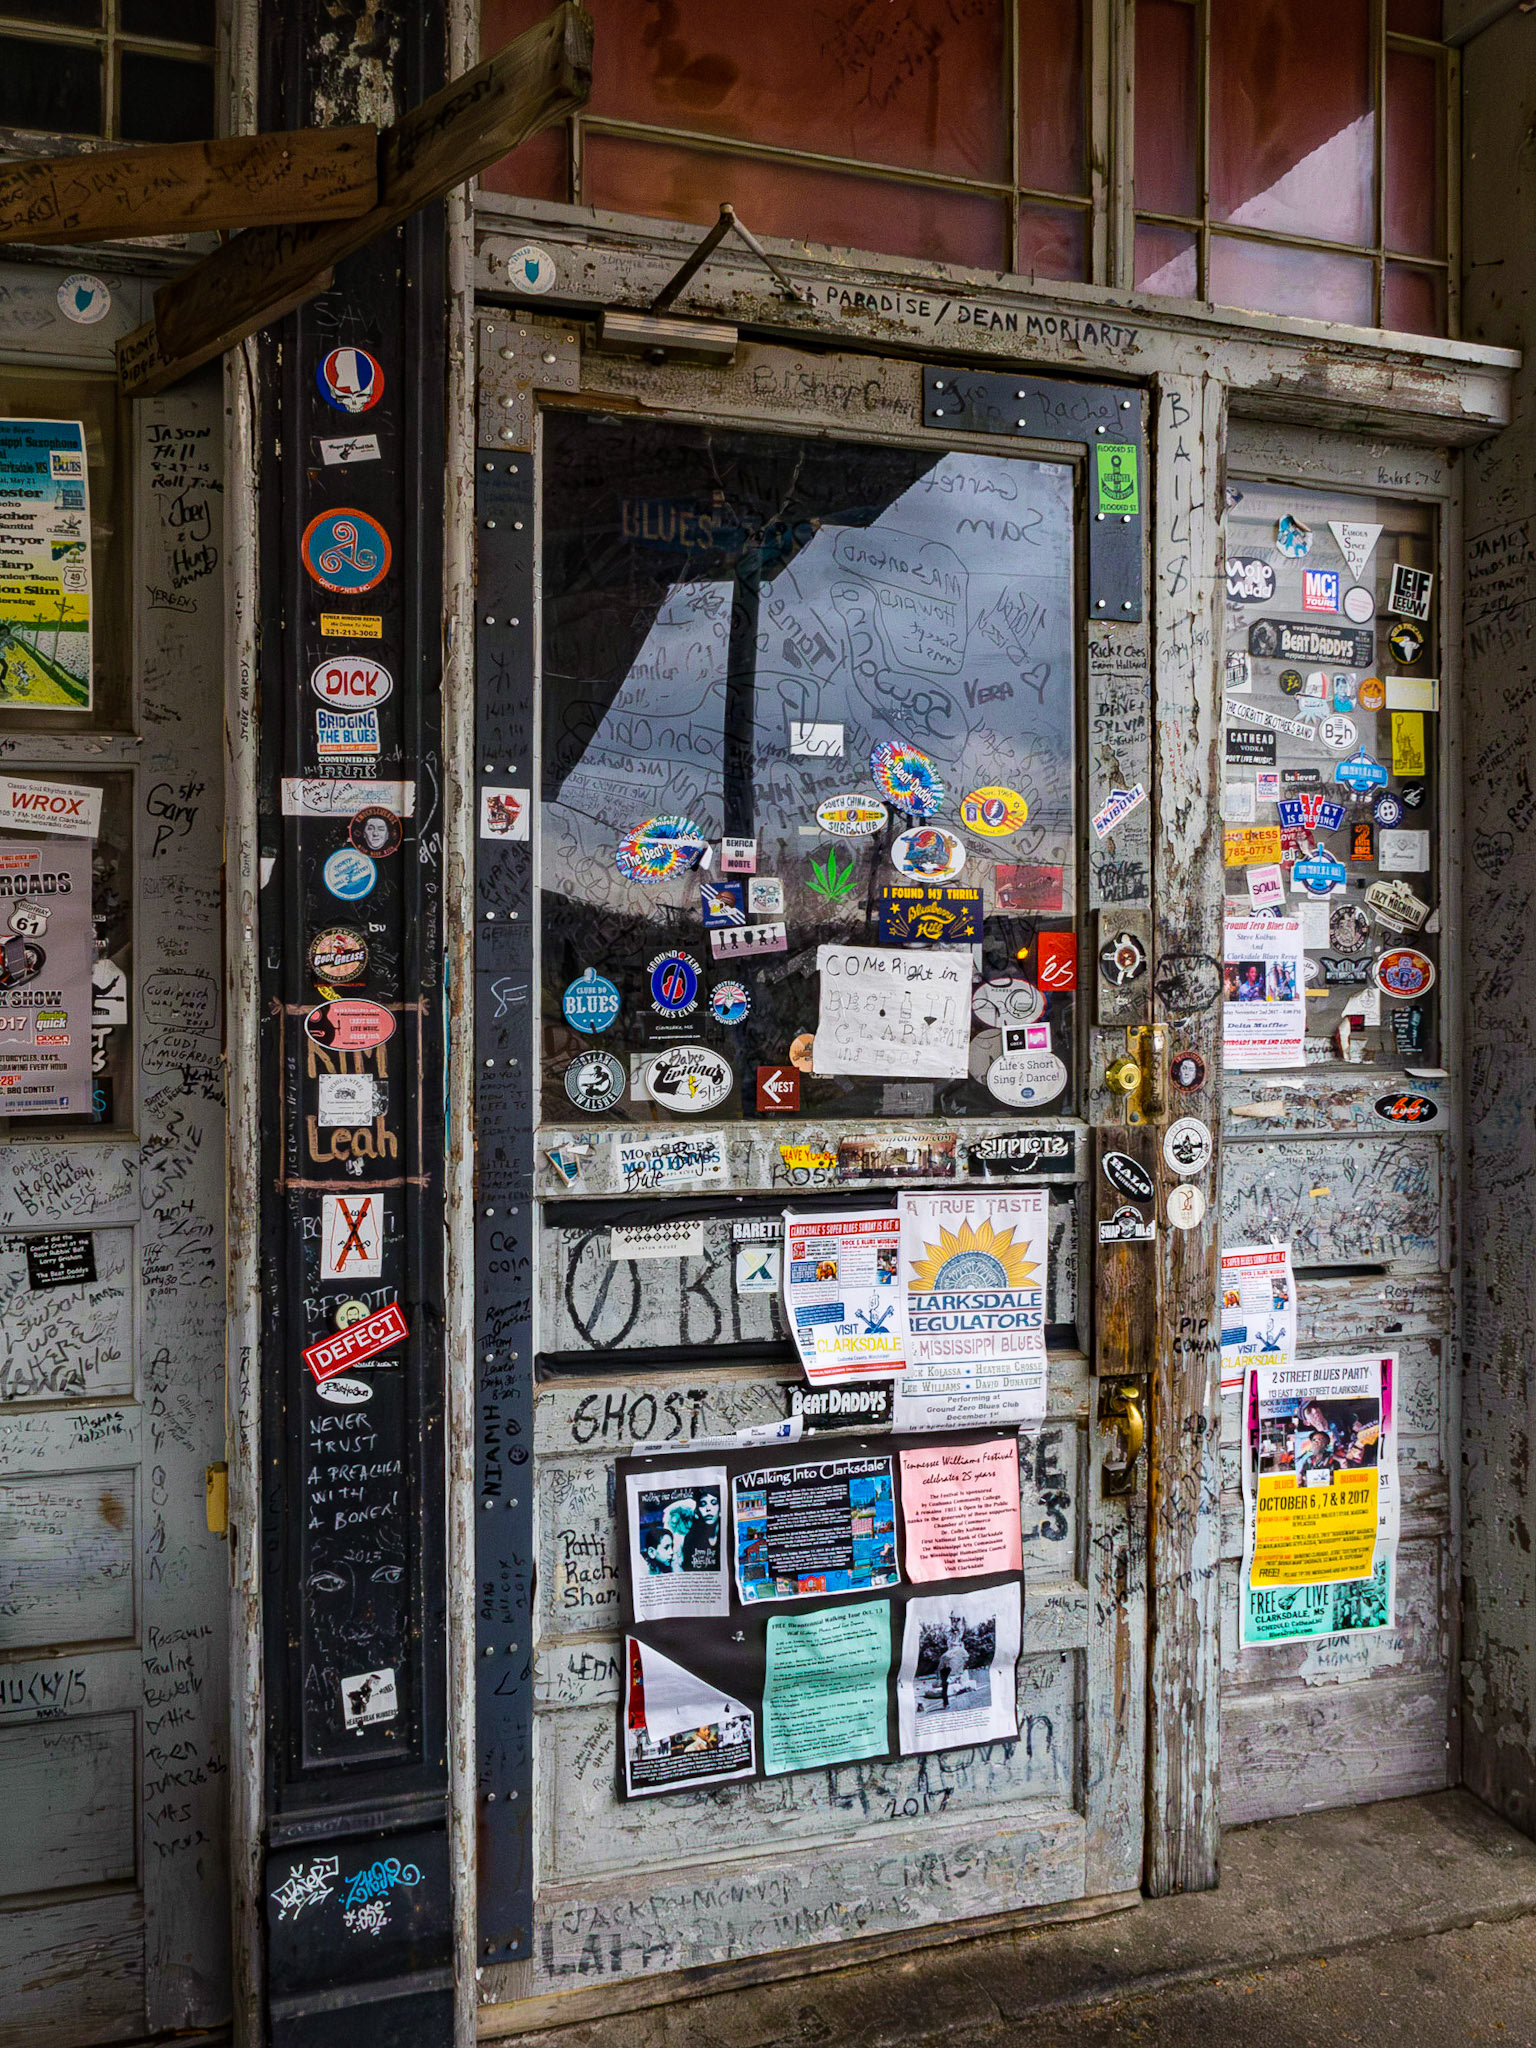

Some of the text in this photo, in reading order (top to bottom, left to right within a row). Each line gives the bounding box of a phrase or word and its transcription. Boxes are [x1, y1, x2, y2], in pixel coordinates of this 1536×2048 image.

[826, 285, 931, 318] PARADISE
[957, 305, 1018, 333] DEAN
[1026, 315, 1138, 347] MORIARTY
[147, 424, 211, 443] JASON
[621, 499, 714, 550] BLUES
[70, 572, 81, 581] 49
[1397, 567, 1429, 600] LEIF
[1306, 598, 1336, 607] TOURS
[1405, 590, 1416, 599] DE
[1393, 596, 1426, 618] LEEUW
[325, 628, 378, 637] 321-213-3002
[326, 668, 379, 697] DICK
[963, 678, 1014, 709] VERA
[318, 710, 376, 729] BRIDGING
[1237, 703, 1263, 725] CORBITT
[1265, 713, 1295, 732] BROTHERS
[1296, 724, 1313, 739] BAND
[319, 730, 377, 743] THE BLUES
[1230, 732, 1274, 744] CATHEAD
[318, 755, 376, 764] COMUNIDAD
[878, 747, 938, 810] The Beat Daddys
[1284, 772, 1316, 781] believer
[11, 792, 84, 816] WROX
[147, 783, 199, 837] Gary
[823, 796, 881, 809] SOUTH CHINA SEA
[1096, 788, 1144, 833] SKIBOWL
[827, 820, 878, 835] SURF CLUB
[1287, 814, 1335, 826] IS BREWING
[152, 826, 168, 858] P.
[726, 839, 754, 848] BENFICA
[1227, 845, 1274, 857] 785-0775
[622, 842, 668, 868] The Beat
[735, 849, 744, 859] OU
[727, 860, 751, 869] MORTE
[0, 873, 72, 896] ROADS
[1252, 881, 1281, 895] SOUL
[883, 887, 980, 901] I FOUND MY THRILL
[18, 902, 50, 918] HIGHWAY
[908, 902, 957, 924] Blueberry
[1371, 888, 1422, 922] LAZY MAGNOLIA
[16, 920, 40, 935] 61
[915, 922, 944, 940] Hill
[1381, 931, 1418, 948] ROD
[314, 950, 365, 967] COCK GREASE
[646, 950, 703, 976] GROUND ZERO
[1226, 953, 1261, 961] Clarksdale
[891, 956, 934, 982] Right
[942, 966, 960, 983] in
[11, 990, 62, 1006] SHOW
[565, 995, 620, 1015] BLUES
[650, 999, 699, 1019] BLUES CLUB
[36, 1017, 67, 1031] quick
[578, 1052, 613, 1068] DYLAN
[999, 1059, 1055, 1071] Life's Short
[770, 1081, 795, 1094] WEST
[993, 1072, 1059, 1086] Sing Dance!
[23, 1085, 55, 1094] CONTEST
[575, 1091, 619, 1111] WALSHE
[1392, 1096, 1422, 1121] 66
[306, 1115, 398, 1160] Leah
[13, 1156, 74, 1206] Happy
[1110, 1156, 1151, 1195] HALO
[45, 1181, 97, 1220] Susie
[906, 1198, 1043, 1217] A TRUE TASTE
[36, 1271, 48, 1279] The
[834, 1323, 858, 1336] VISIT
[1179, 1316, 1209, 1335] PIP
[315, 1313, 396, 1368] DEFECT
[816, 1337, 902, 1353] CLARKSDALE
[919, 1333, 1043, 1360] MISSISSIPPI BLUES
[1173, 1336, 1221, 1354] COWAN
[1237, 1343, 1258, 1354] VISIT
[1221, 1353, 1288, 1369] CLARKSDALE
[1272, 1366, 1370, 1384] 2 STREET BLUES PARTY
[926, 1401, 1020, 1413] Ground Zero Blues Club
[947, 1395, 991, 1404] Performing
[310, 1412, 371, 1434] NEVER
[571, 1388, 708, 1443] GHOST
[310, 1434, 376, 1454] TRUST
[482, 1403, 502, 1496] NIAMH
[903, 1449, 1014, 1470] Tennessee Williams Festival
[792, 1468, 818, 1484] Into
[922, 1471, 996, 1485] celebrates 25 years
[1273, 1473, 1369, 1490] BLUES BUSKING
[312, 1486, 364, 1503] WITH
[1259, 1495, 1308, 1512] OCTOBER
[1322, 1493, 1329, 1507] 7
[1330, 1492, 1338, 1505] &
[1340, 1491, 1346, 1504] 8
[1348, 1489, 1370, 1504] 2017
[558, 1528, 606, 1557] Patti
[1250, 1584, 1329, 1616] FREE LIVE
[1314, 1608, 1325, 1616] MS
